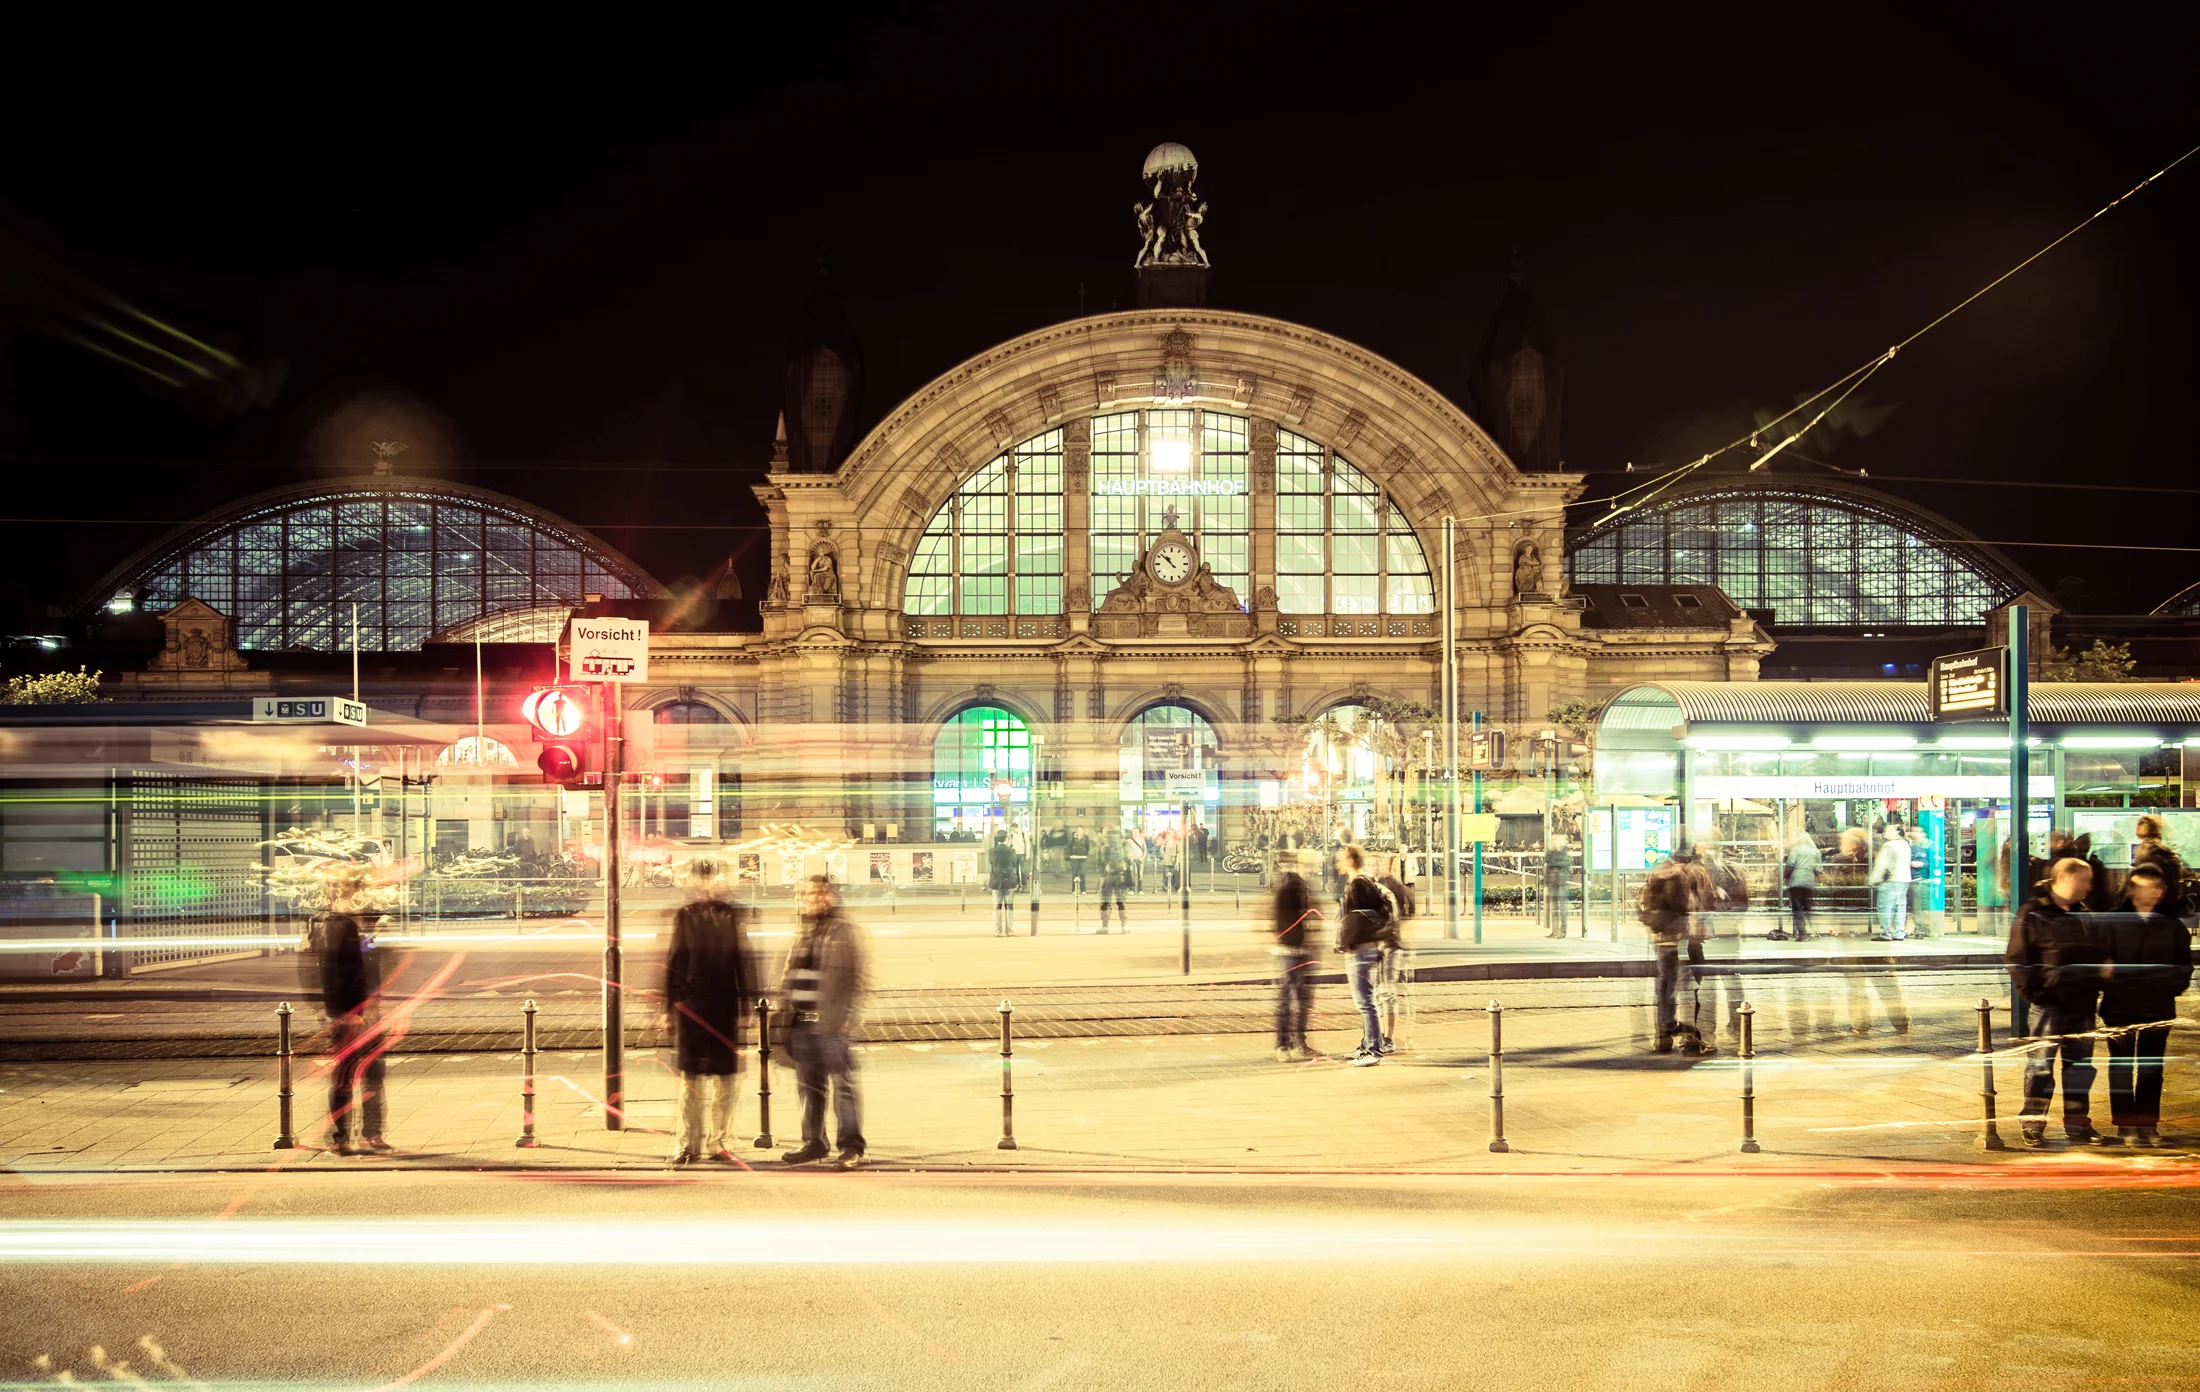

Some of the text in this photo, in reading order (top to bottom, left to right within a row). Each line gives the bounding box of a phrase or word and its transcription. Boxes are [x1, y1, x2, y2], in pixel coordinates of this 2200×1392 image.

[1098, 479, 1244, 495] HAUPTBAHNHOF
[1940, 656, 1978, 671] Hauptbahnhof
[296, 703, 322, 715] S U
[1814, 782, 1895, 796] Hauptbahnhof
